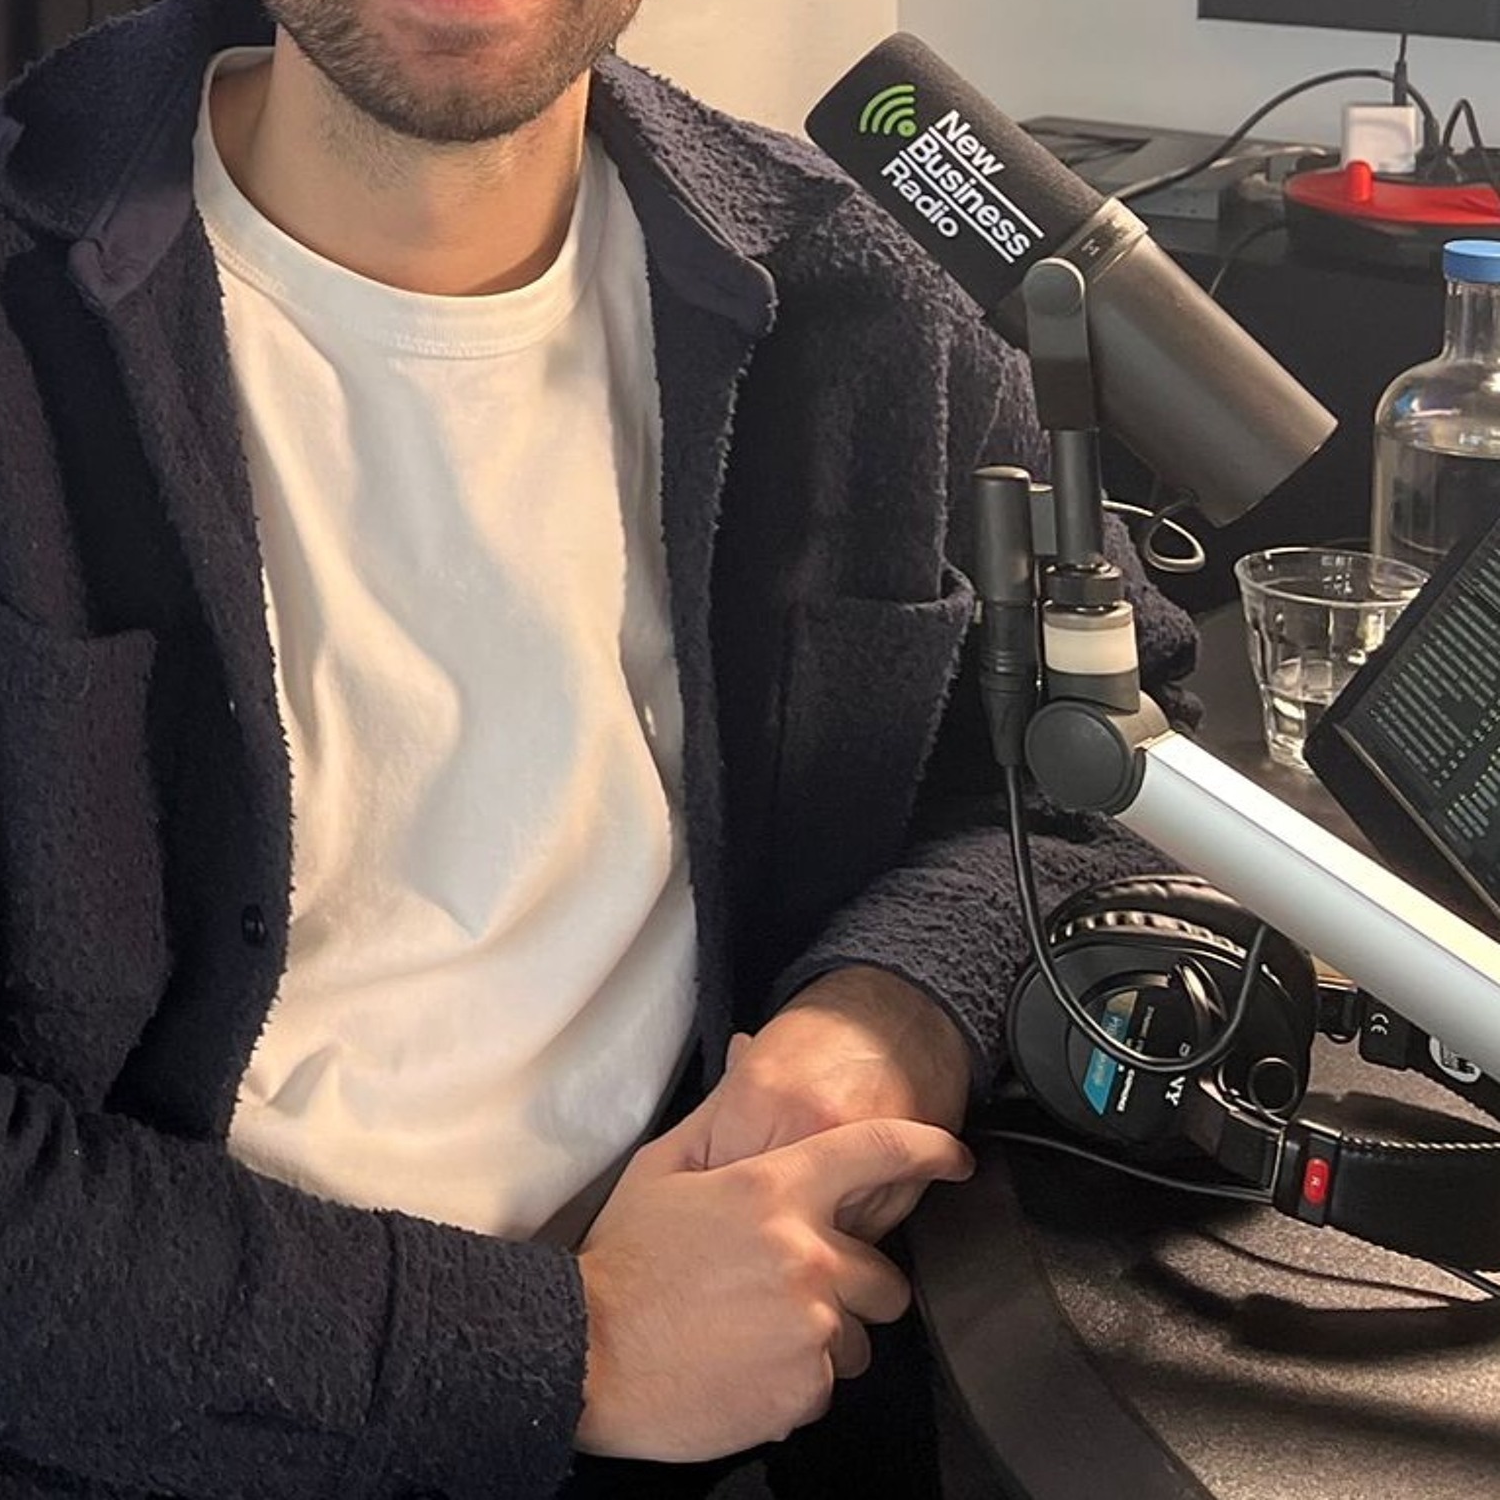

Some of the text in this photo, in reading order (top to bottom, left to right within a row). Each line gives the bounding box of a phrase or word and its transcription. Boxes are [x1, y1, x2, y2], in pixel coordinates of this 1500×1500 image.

[935, 109, 1005, 178] New
[880, 157, 959, 238] Radio
[905, 133, 1031, 257] Business
